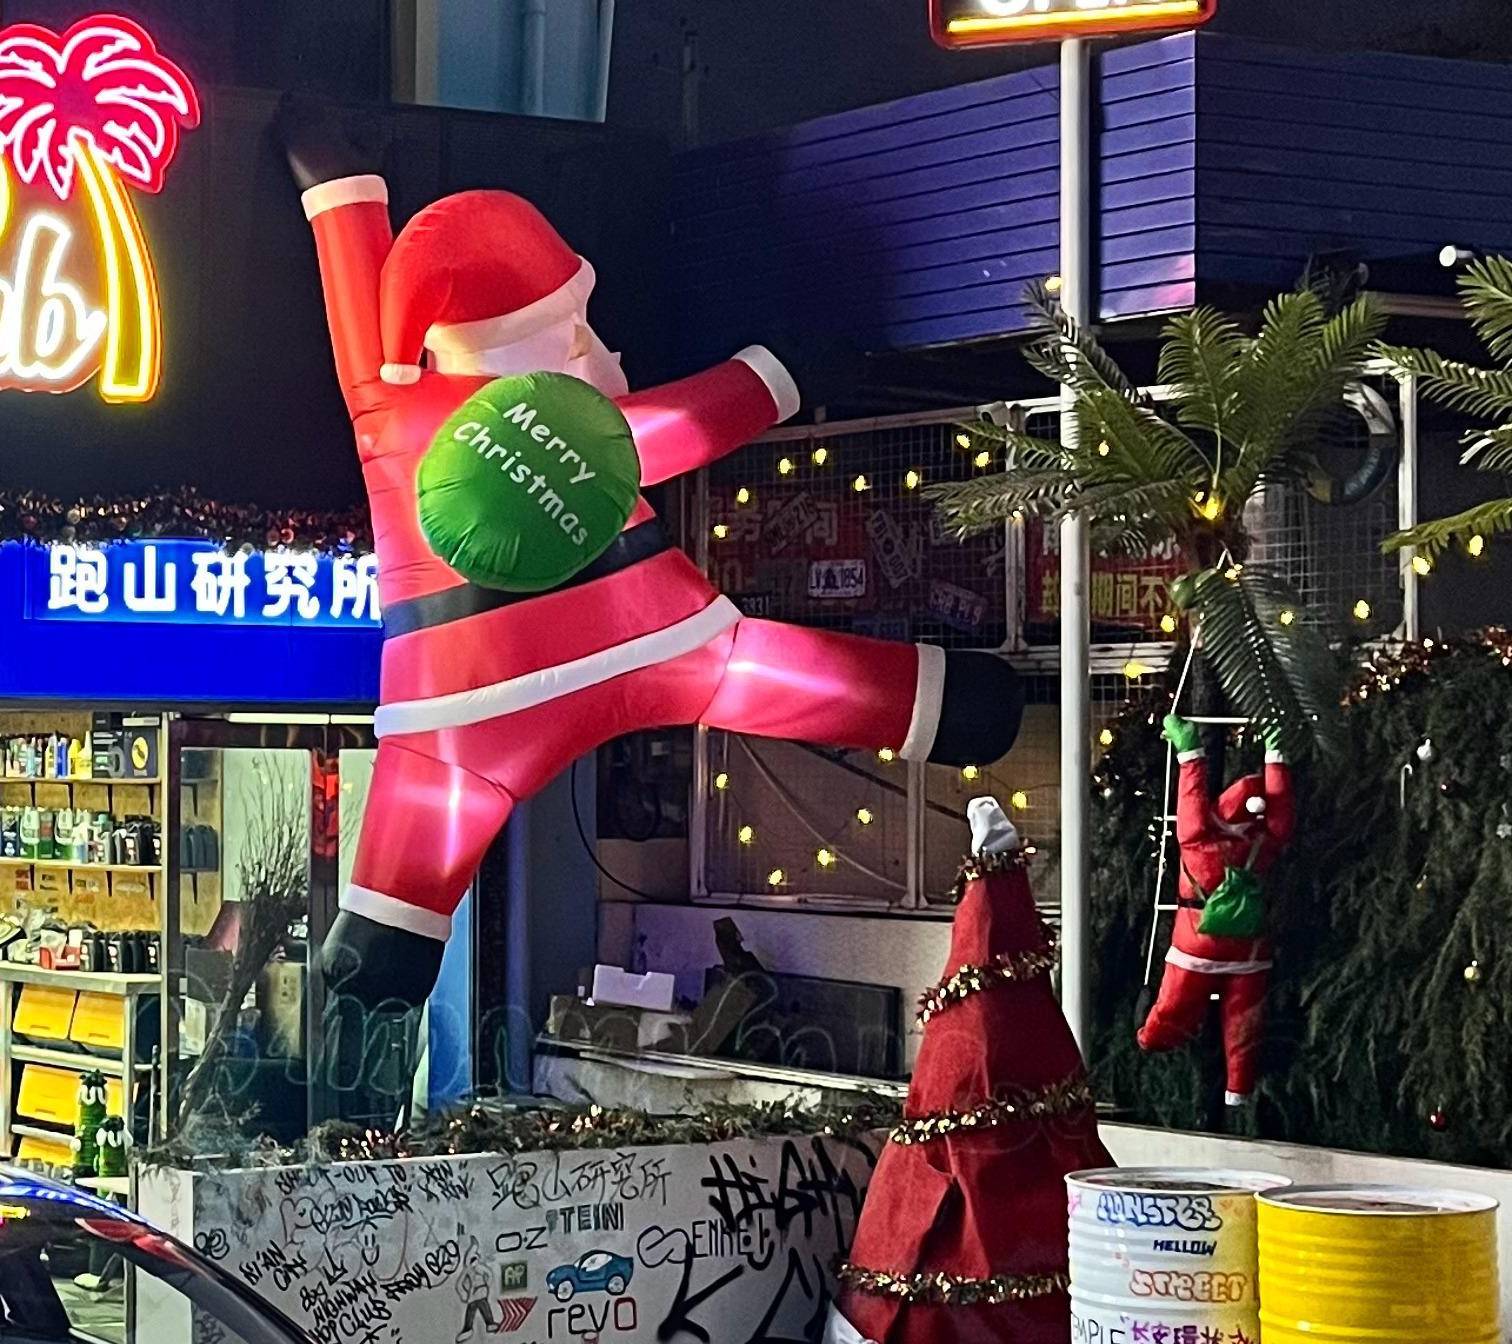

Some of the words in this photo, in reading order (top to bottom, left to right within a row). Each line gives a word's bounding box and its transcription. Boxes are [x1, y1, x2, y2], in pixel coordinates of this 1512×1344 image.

[503, 402, 596, 485] Merry
[454, 421, 588, 546] Christmas
[47, 544, 381, 620] 跑山研究所
[487, 1152, 672, 1210] 跑山研究所
